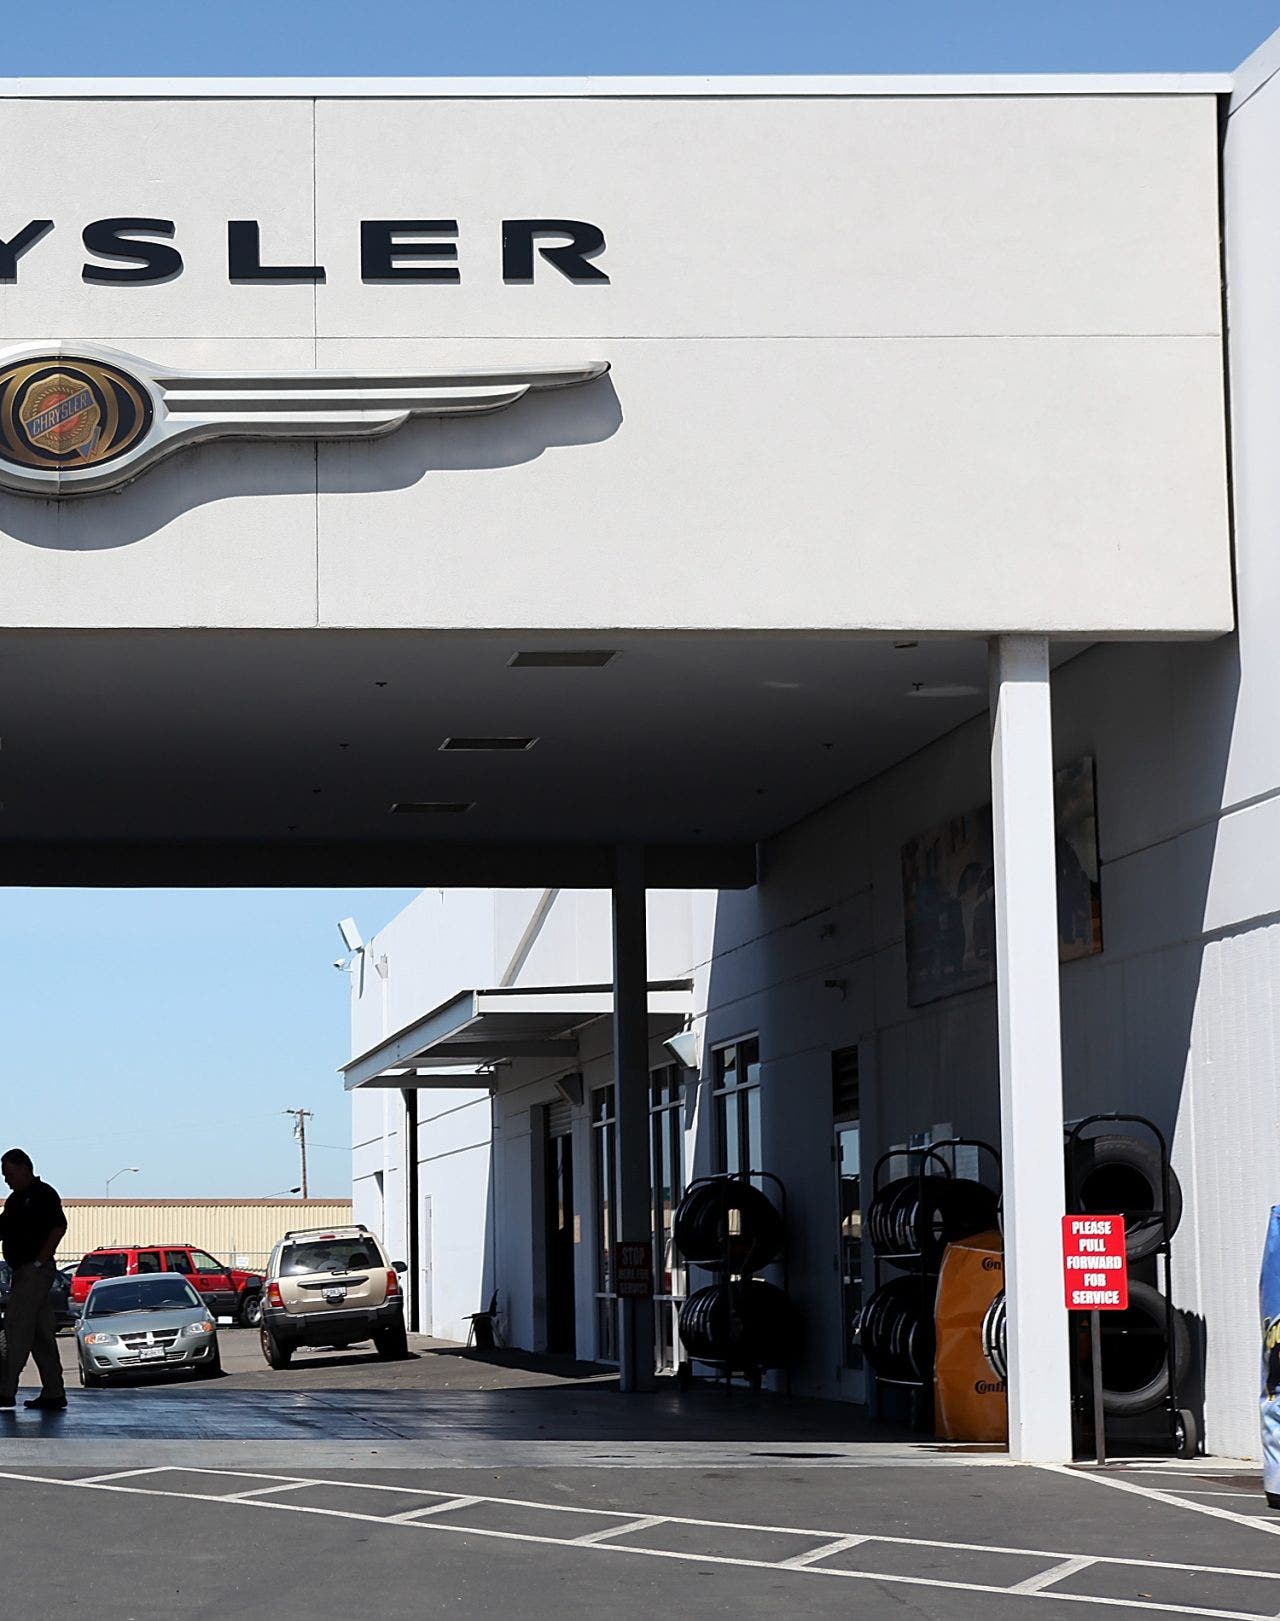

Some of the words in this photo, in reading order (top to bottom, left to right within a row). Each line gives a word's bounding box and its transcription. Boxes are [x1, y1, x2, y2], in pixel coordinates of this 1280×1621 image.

[32, 393, 90, 436] CHRYSLER
[1072, 1221, 1112, 1235] PLEASE
[1079, 1239, 1106, 1252] PULL
[622, 1247, 645, 1264] STOP
[982, 1256, 1001, 1271] Con
[1066, 1256, 1122, 1270] FORWARD
[1083, 1273, 1106, 1287] FOR
[1072, 1290, 1120, 1304] SERVICE
